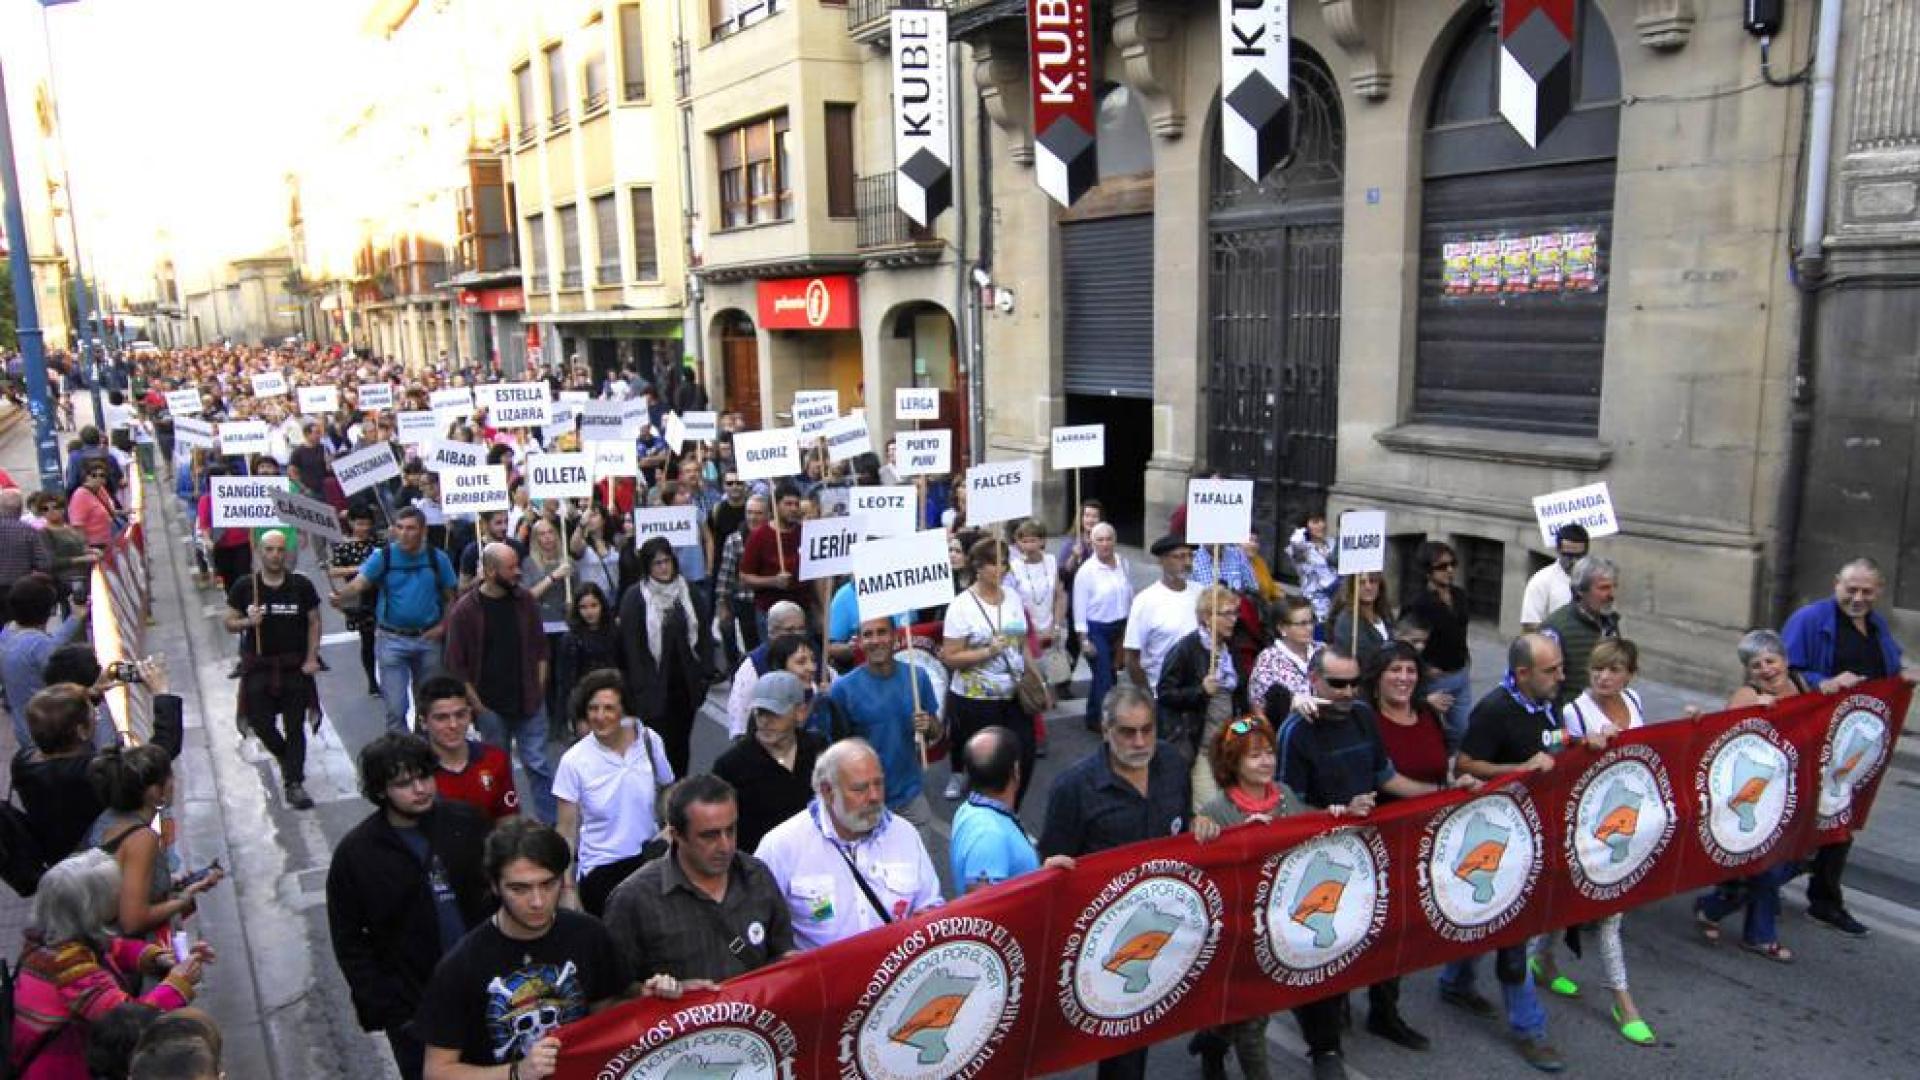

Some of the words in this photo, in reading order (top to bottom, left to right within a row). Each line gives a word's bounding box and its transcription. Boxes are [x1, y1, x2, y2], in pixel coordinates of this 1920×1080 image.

[900, 17, 931, 136] KUBE
[496, 389, 543, 401] ESTELLA
[901, 397, 934, 410] LERGA
[497, 407, 544, 421] LIZARRA
[907, 438, 940, 450] PUEYO
[1056, 433, 1097, 443] LARRAGA
[436, 449, 477, 467] AIBAR
[456, 474, 490, 488] OLITE
[534, 466, 587, 484] OLLETA
[974, 471, 1021, 490] FALCES
[858, 495, 905, 509] LEOTZ
[1194, 492, 1244, 505] TAFALLA
[1541, 494, 1605, 517] MIRANDA
[641, 519, 691, 534] PITILLAS
[809, 528, 858, 561] LERÍN
[1343, 534, 1381, 551] MILAGRO
[858, 562, 949, 596] AMATRIAIN
[1060, 933, 1082, 958] NO
[857, 929, 927, 1008] PODEMOS
[926, 915, 994, 943] PERDER
[672, 1001, 756, 1031] PERDER
